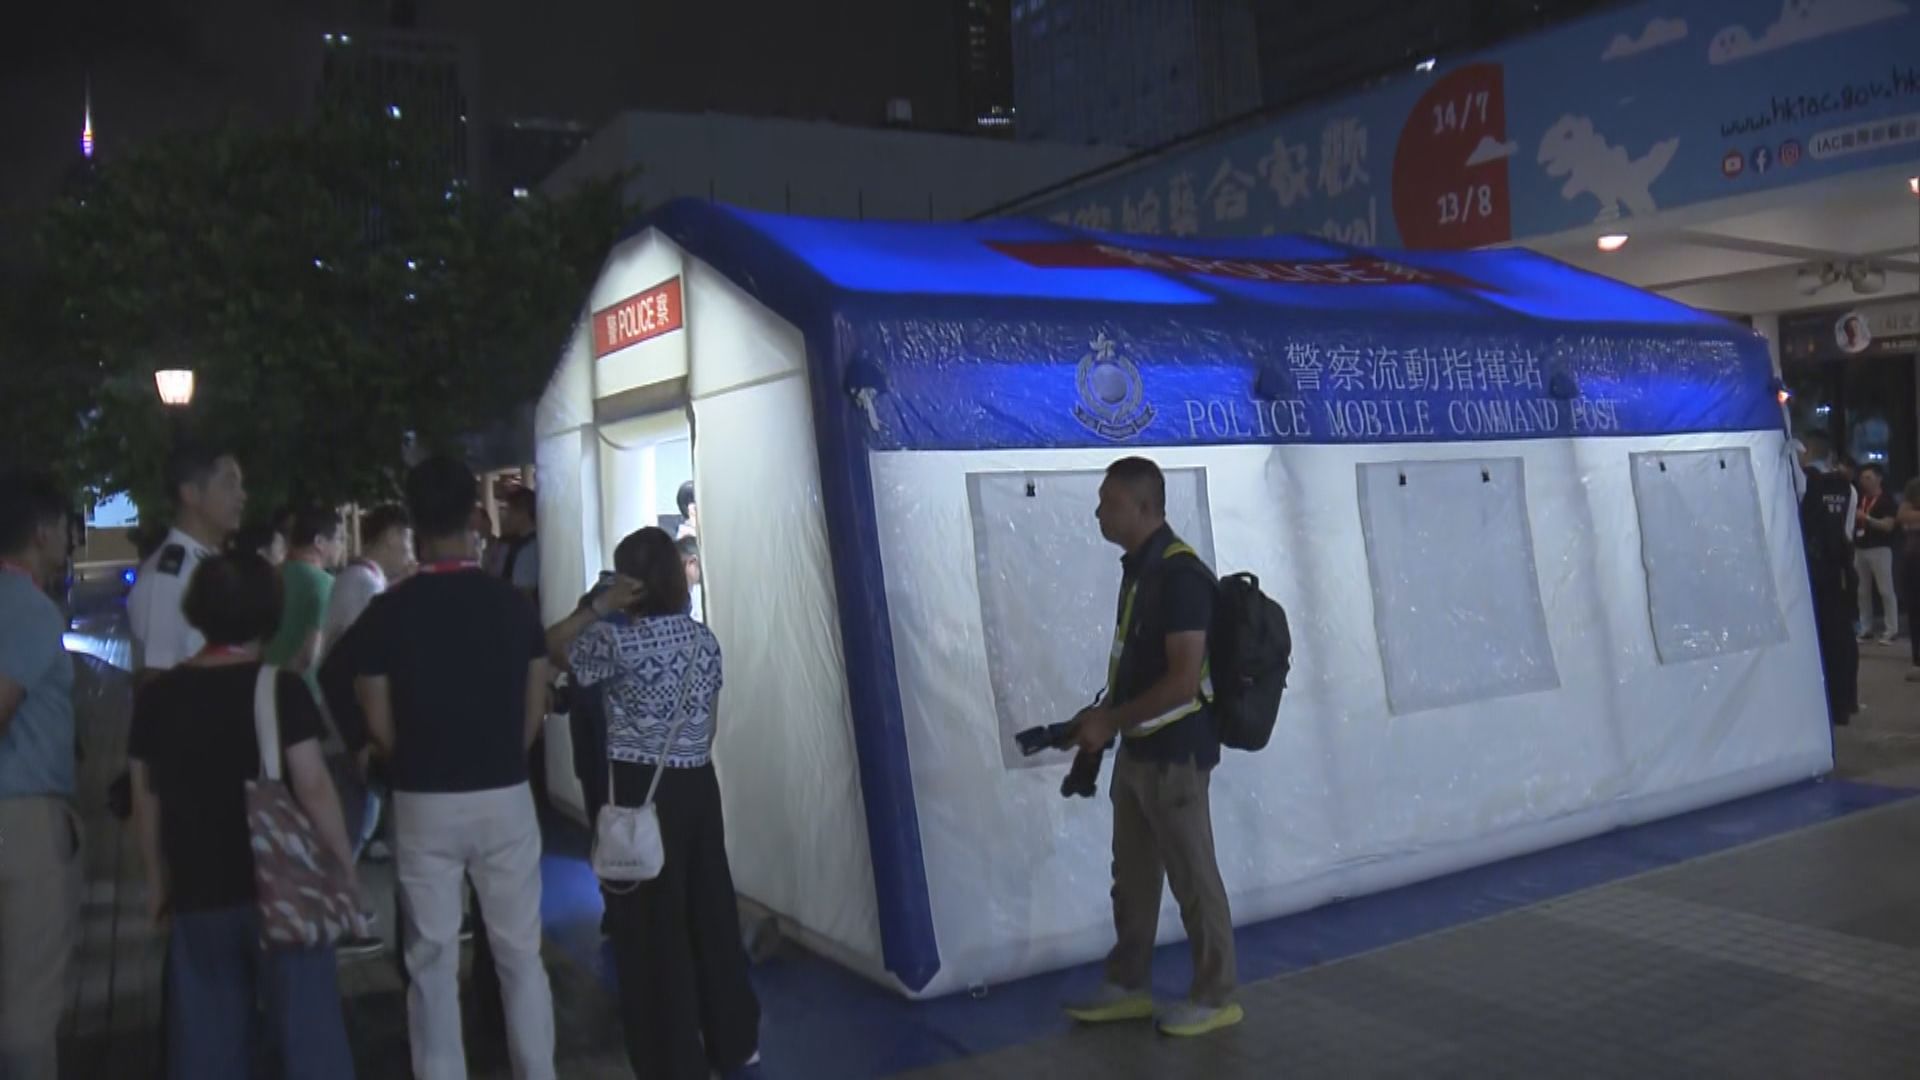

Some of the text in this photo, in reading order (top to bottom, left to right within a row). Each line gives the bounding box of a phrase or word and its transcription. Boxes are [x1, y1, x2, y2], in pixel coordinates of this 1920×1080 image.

[1433, 91, 1488, 134] 14/7
[1438, 184, 1492, 224] 13/8
[618, 296, 656, 341] POLICE
[1286, 343, 1543, 391] 警察流動指揮站
[1185, 400, 1312, 440] POLICE
[1327, 399, 1435, 438] MOBILE
[1448, 398, 1559, 435] COMMAND
[1570, 397, 1619, 431] POST
